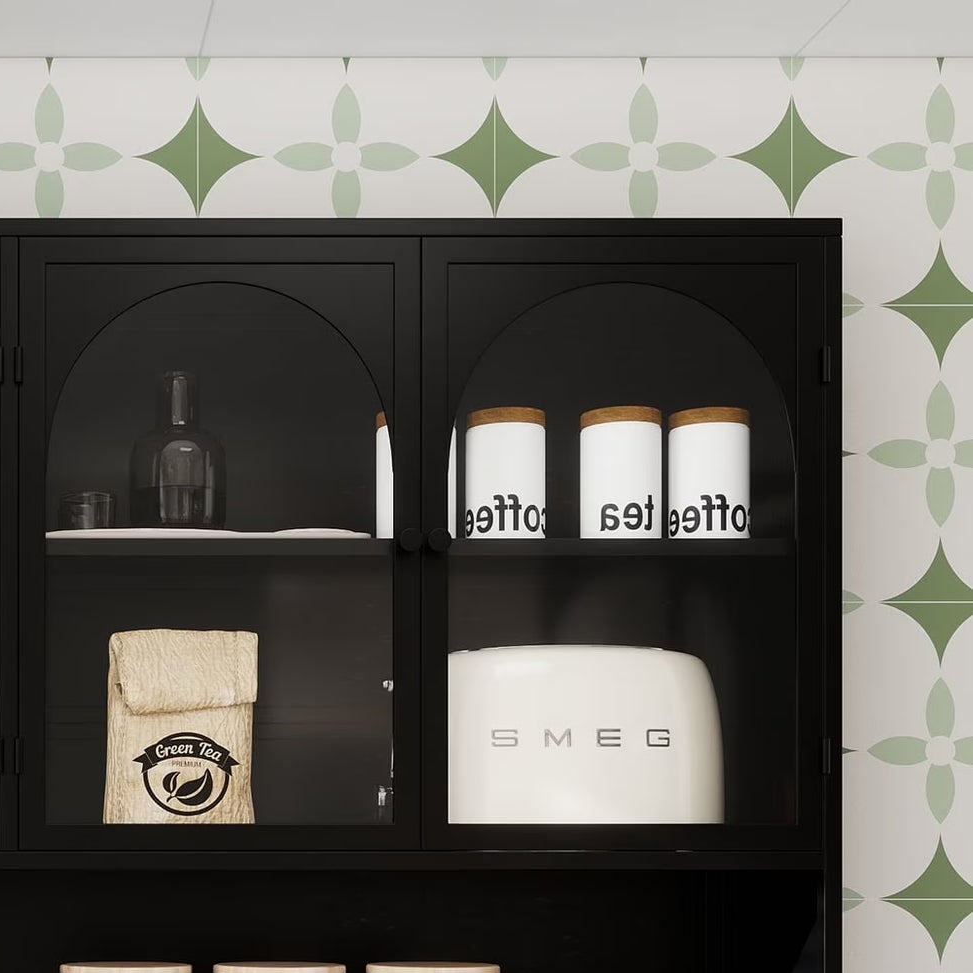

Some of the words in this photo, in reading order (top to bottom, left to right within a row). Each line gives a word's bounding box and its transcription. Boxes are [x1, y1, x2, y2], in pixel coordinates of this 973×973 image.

[491, 728, 670, 748] SMEG
[155, 744, 194, 758] Green
[199, 742, 222, 761] Tea
